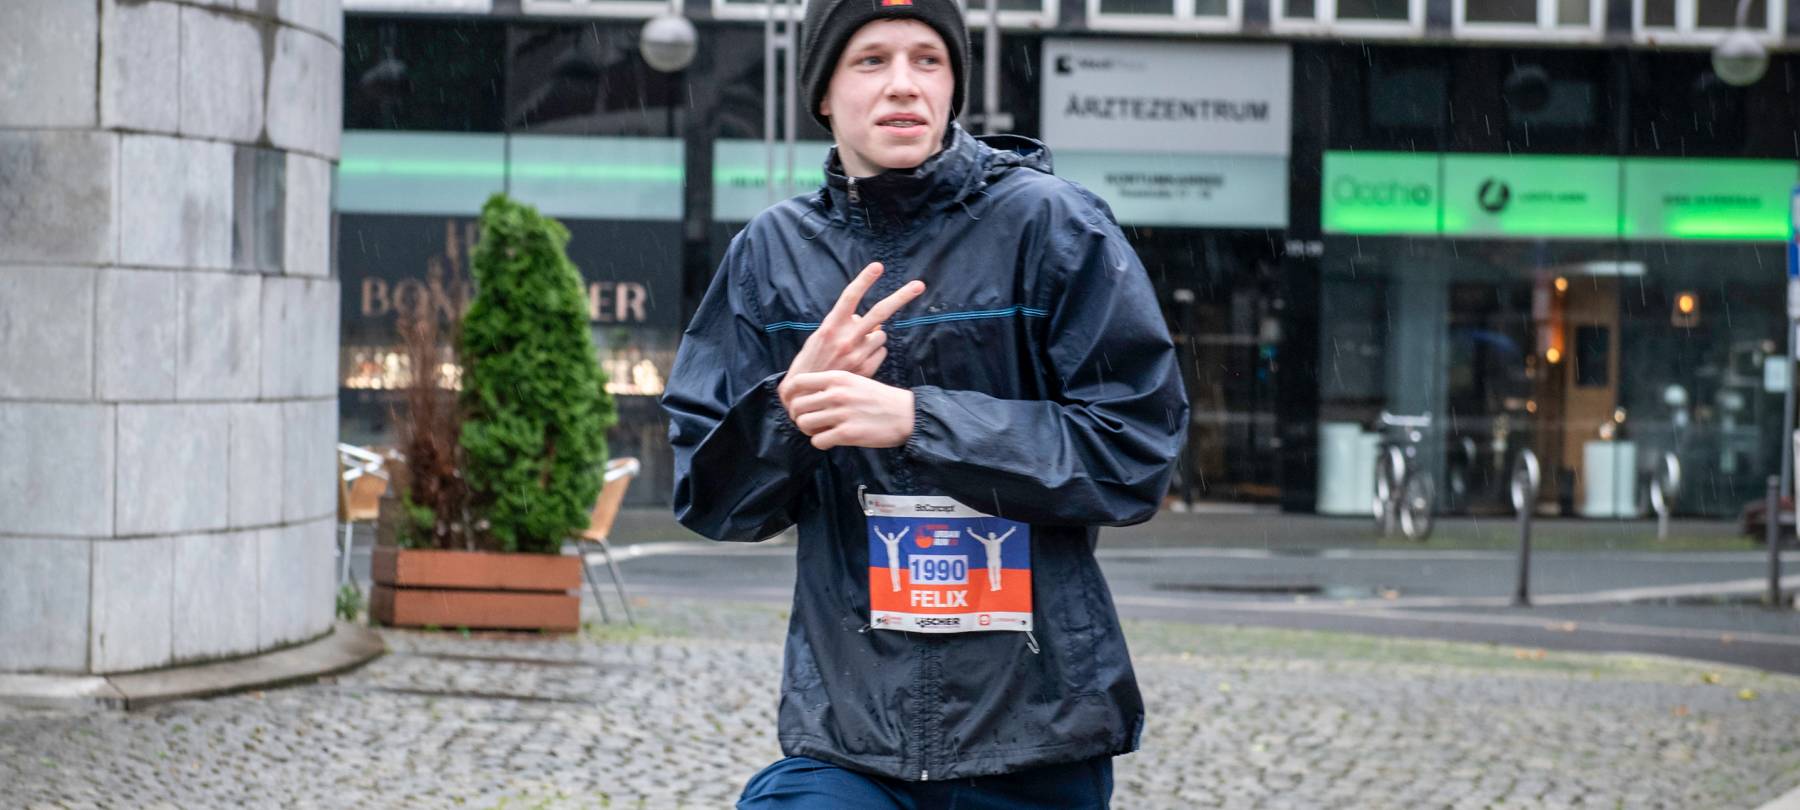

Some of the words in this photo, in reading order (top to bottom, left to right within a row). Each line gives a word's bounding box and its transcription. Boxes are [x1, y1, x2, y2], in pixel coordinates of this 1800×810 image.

[1064, 92, 1270, 123] ÄRZTEZENTRUM
[1332, 175, 1432, 207] Occhio
[914, 503, 955, 514] BoConcept
[911, 559, 966, 581] 1990
[910, 590, 968, 608] FELIX
